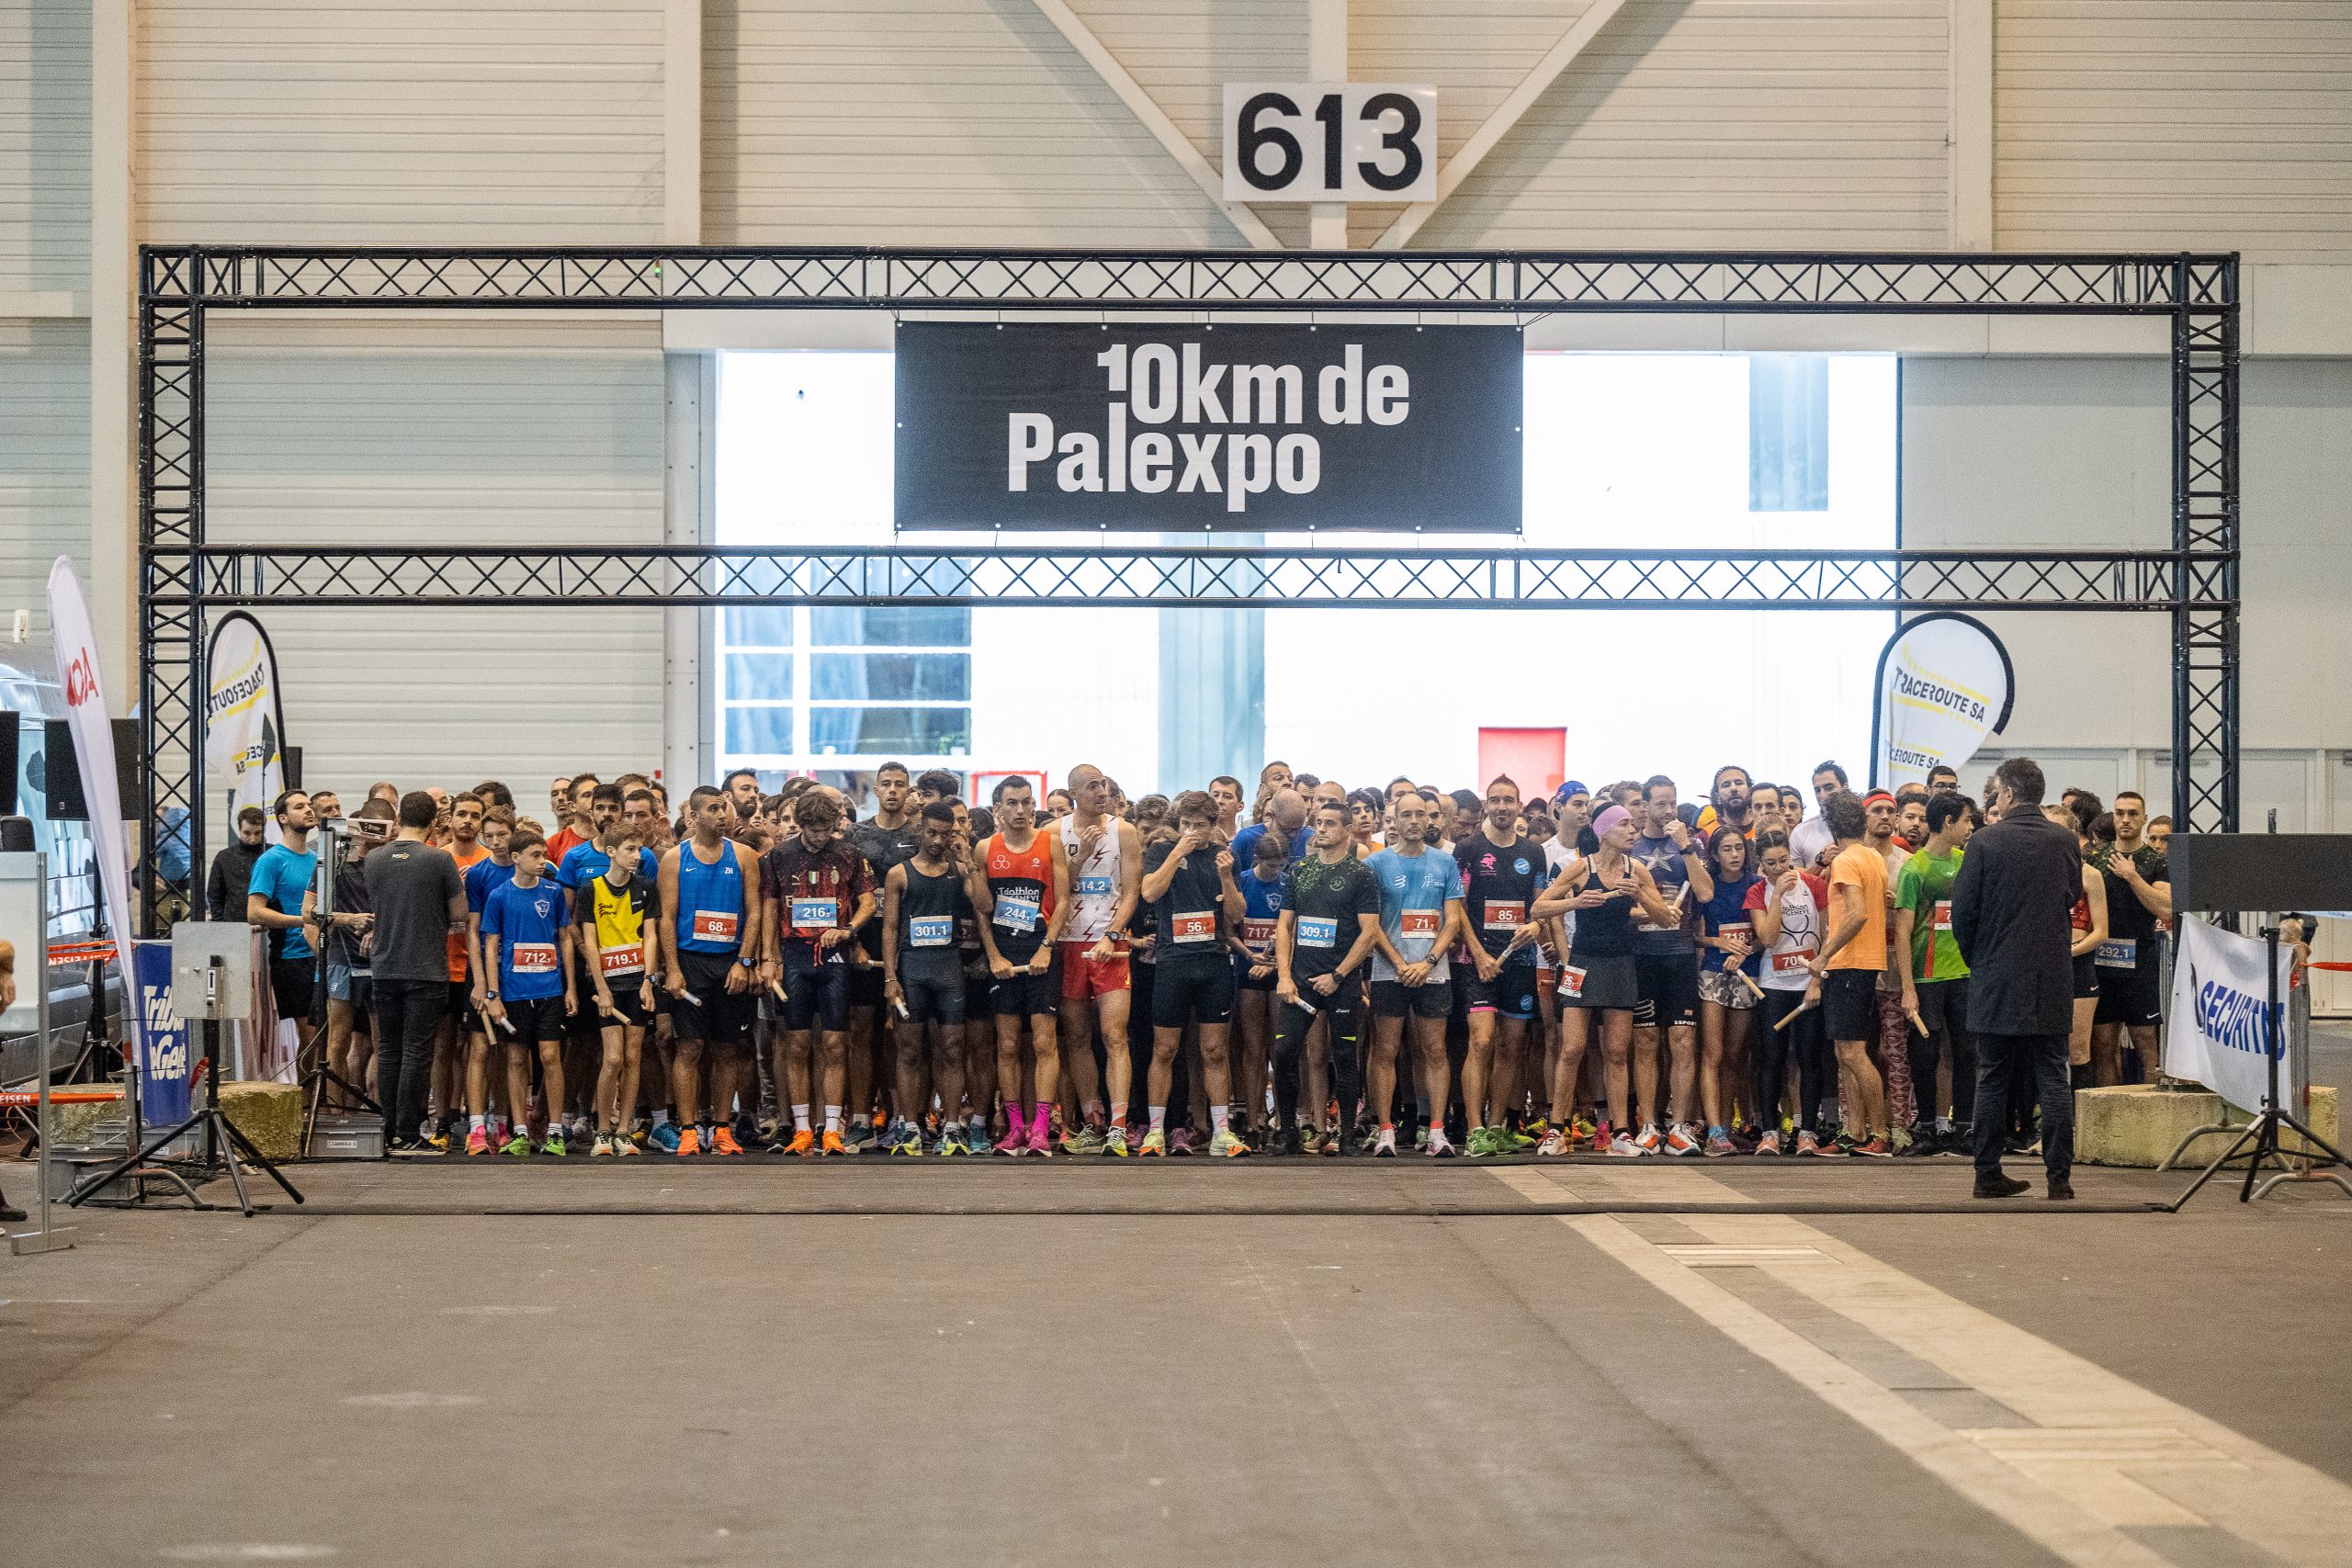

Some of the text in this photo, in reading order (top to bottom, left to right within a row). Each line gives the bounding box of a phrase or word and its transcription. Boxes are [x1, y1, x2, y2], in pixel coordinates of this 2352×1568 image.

[1237, 92, 1423, 192] 613
[1097, 343, 1410, 426] 10km de
[1009, 402, 1321, 513] Palexpo
[1893, 666, 1985, 722] TRACEROUTE SA
[915, 925, 947, 937] 301.1
[1301, 925, 1329, 939] 309.1
[605, 953, 639, 967] 719.1
[2098, 946, 2130, 959] 292.1
